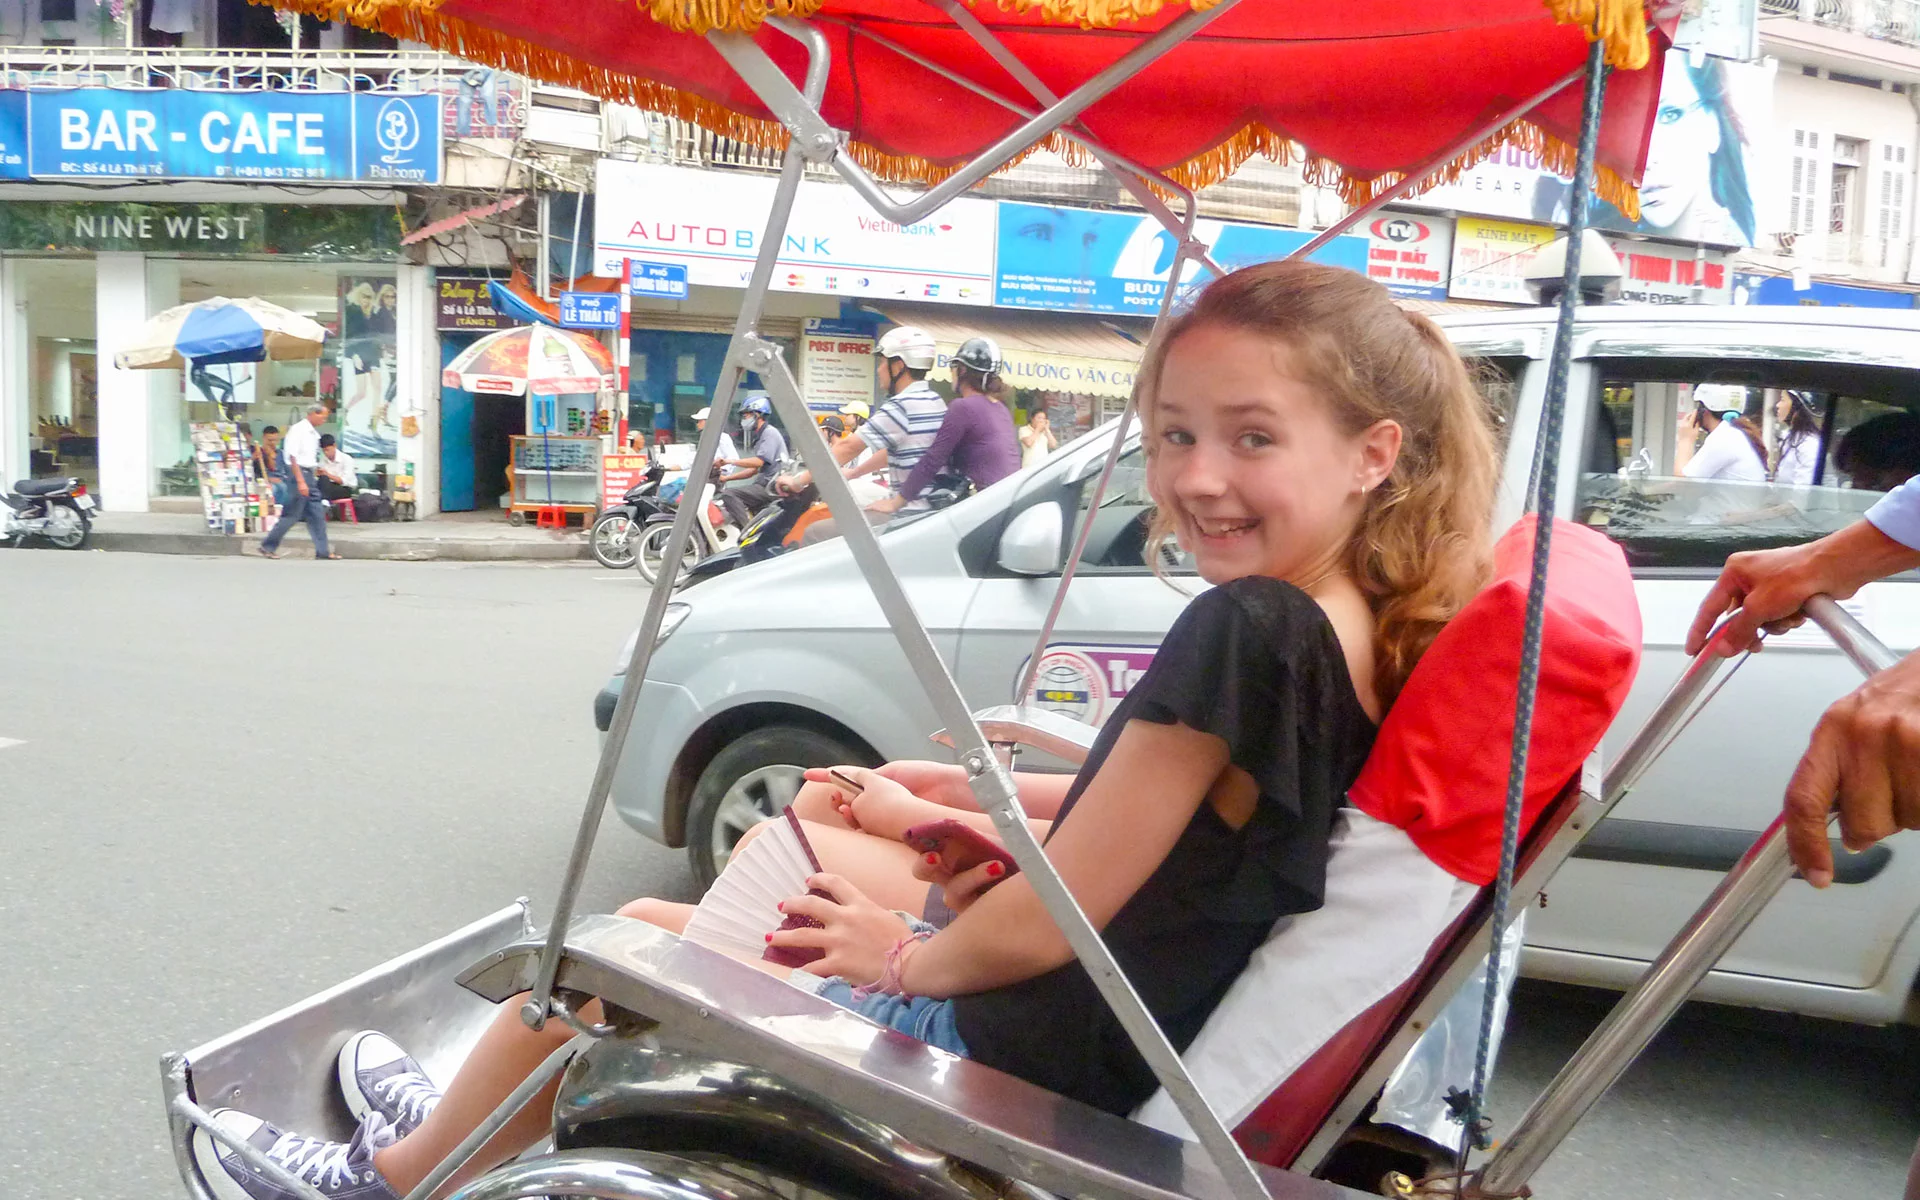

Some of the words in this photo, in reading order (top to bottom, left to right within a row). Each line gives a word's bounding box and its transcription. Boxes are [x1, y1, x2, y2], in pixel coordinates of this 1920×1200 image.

[60, 108, 159, 151] BAR
[200, 111, 325, 155] CAFE
[369, 164, 426, 181] Balcony
[75, 215, 152, 238] NINE
[164, 216, 250, 240] WEST
[627, 221, 830, 255] AUTOBNK
[1124, 281, 1160, 295] BƯU
[581, 298, 600, 307] PHỐ
[1123, 296, 1156, 306] POST
[564, 306, 577, 322] LÊ
[578, 308, 602, 323] THÁI
[808, 340, 835, 352] POST
[838, 342, 872, 355] OFFICE
[1017, 360, 1071, 380] LƯƠNG
[1077, 366, 1107, 383] VĂN
